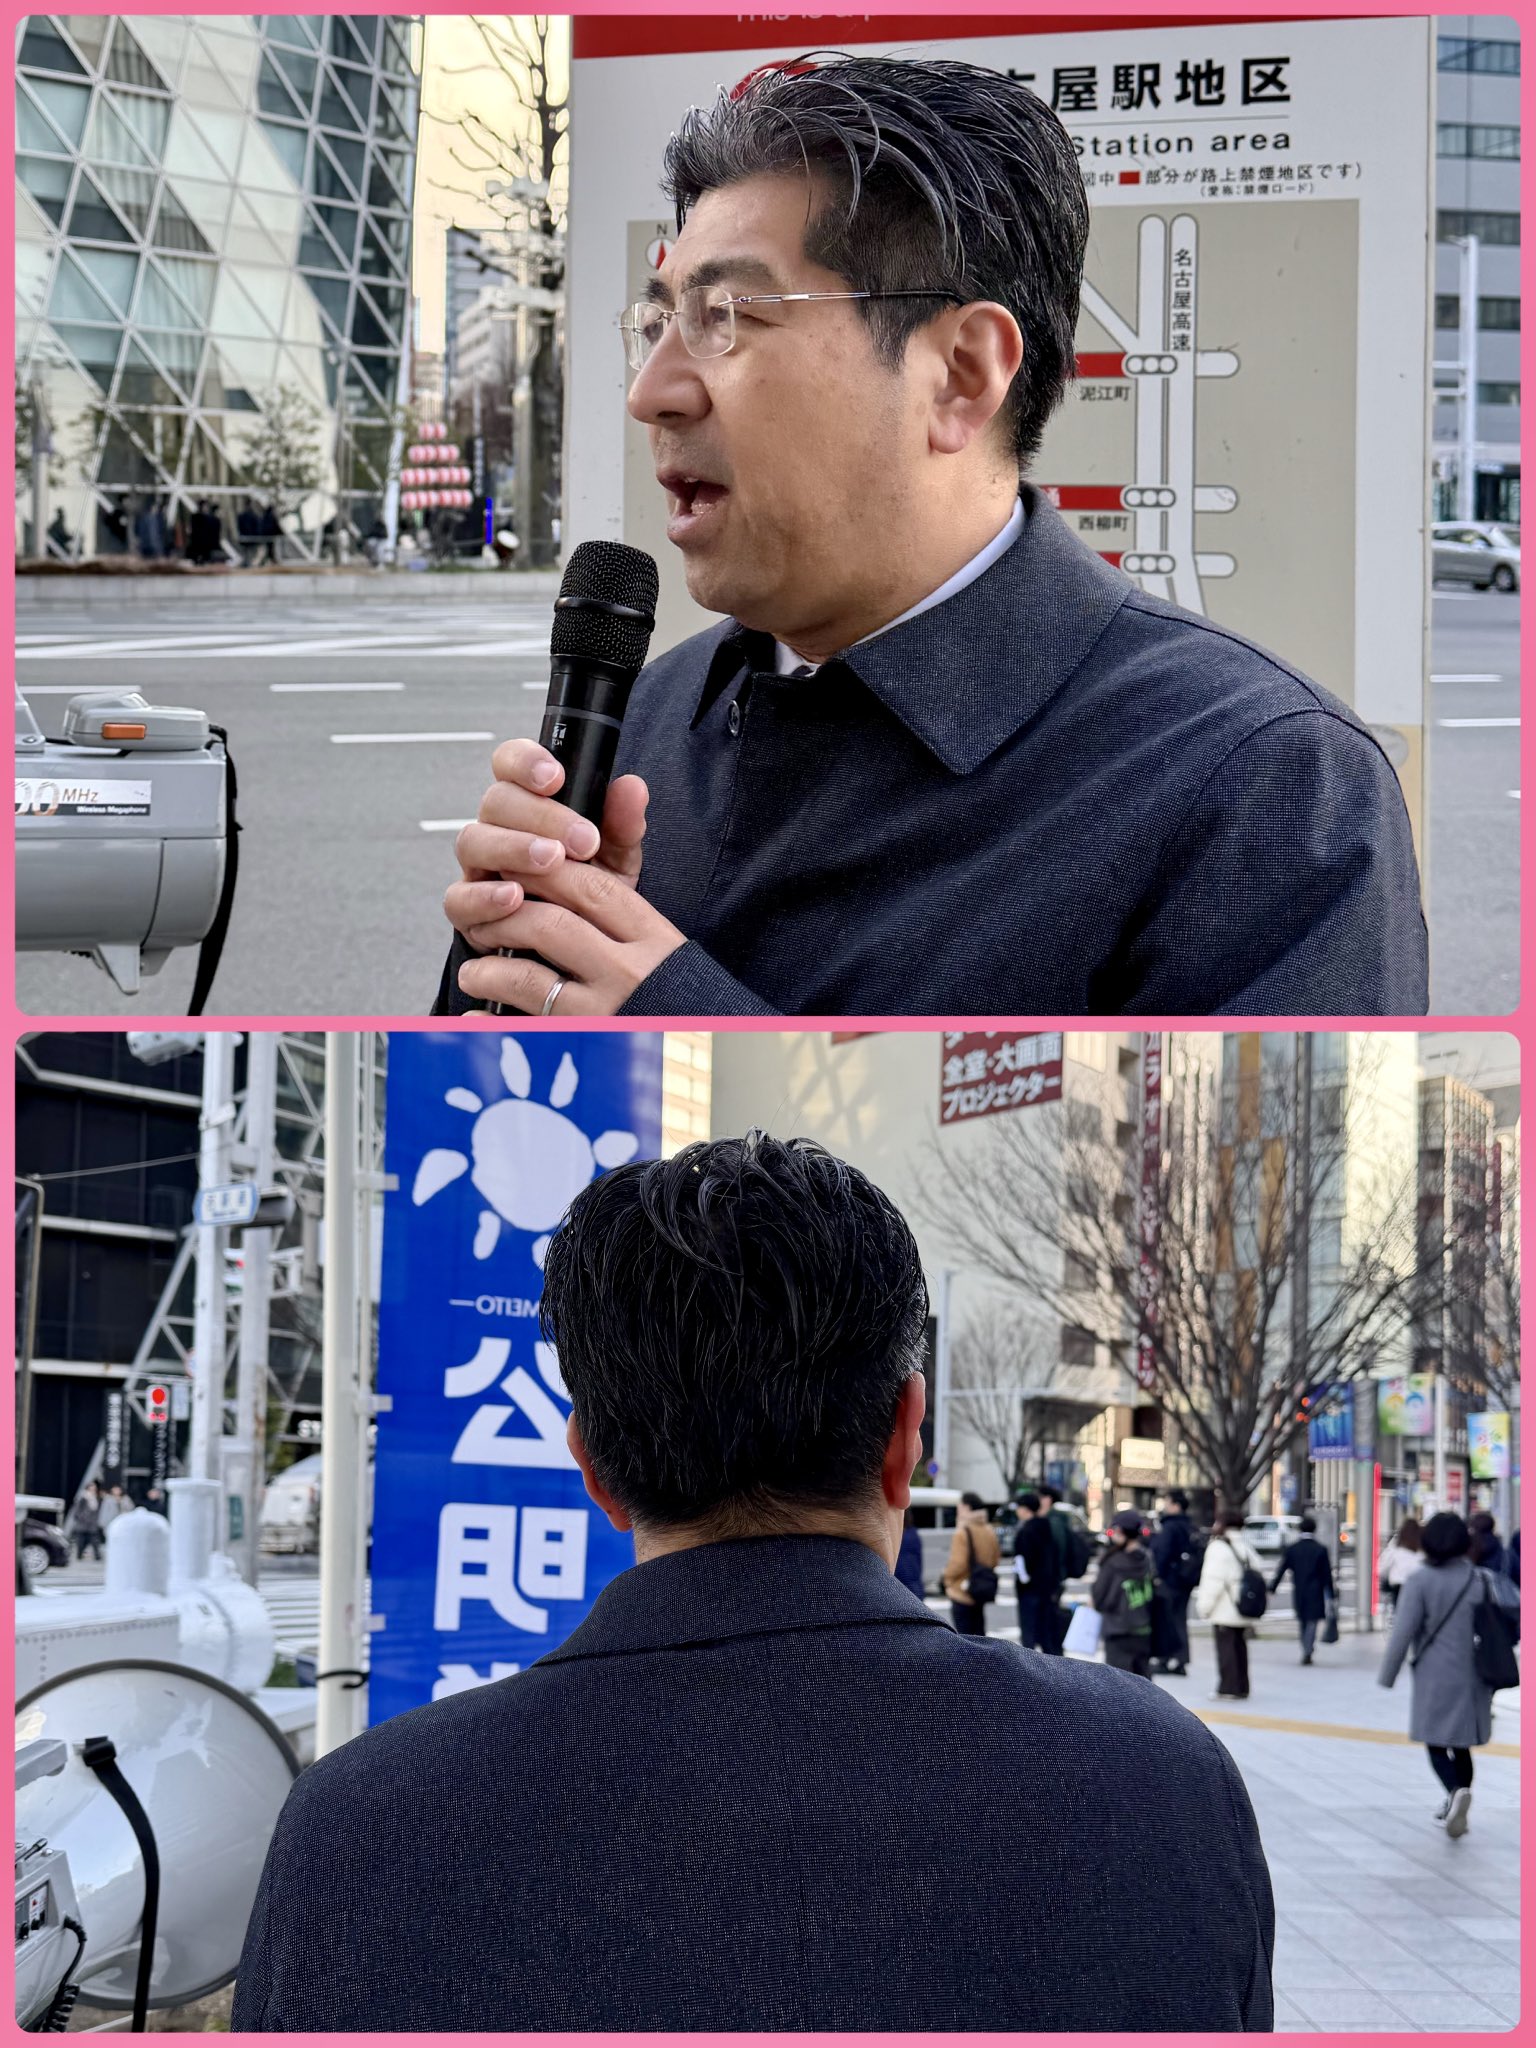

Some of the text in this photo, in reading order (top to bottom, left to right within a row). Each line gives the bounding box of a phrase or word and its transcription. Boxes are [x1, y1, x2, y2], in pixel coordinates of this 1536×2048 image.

[1073, 130, 1291, 157] Station area
[656, 223, 667, 235] N
[1172, 248, 1193, 352] 名古屋高速
[62, 788, 99, 803] MHz
[943, 1071, 1061, 1119] プロジェクター
